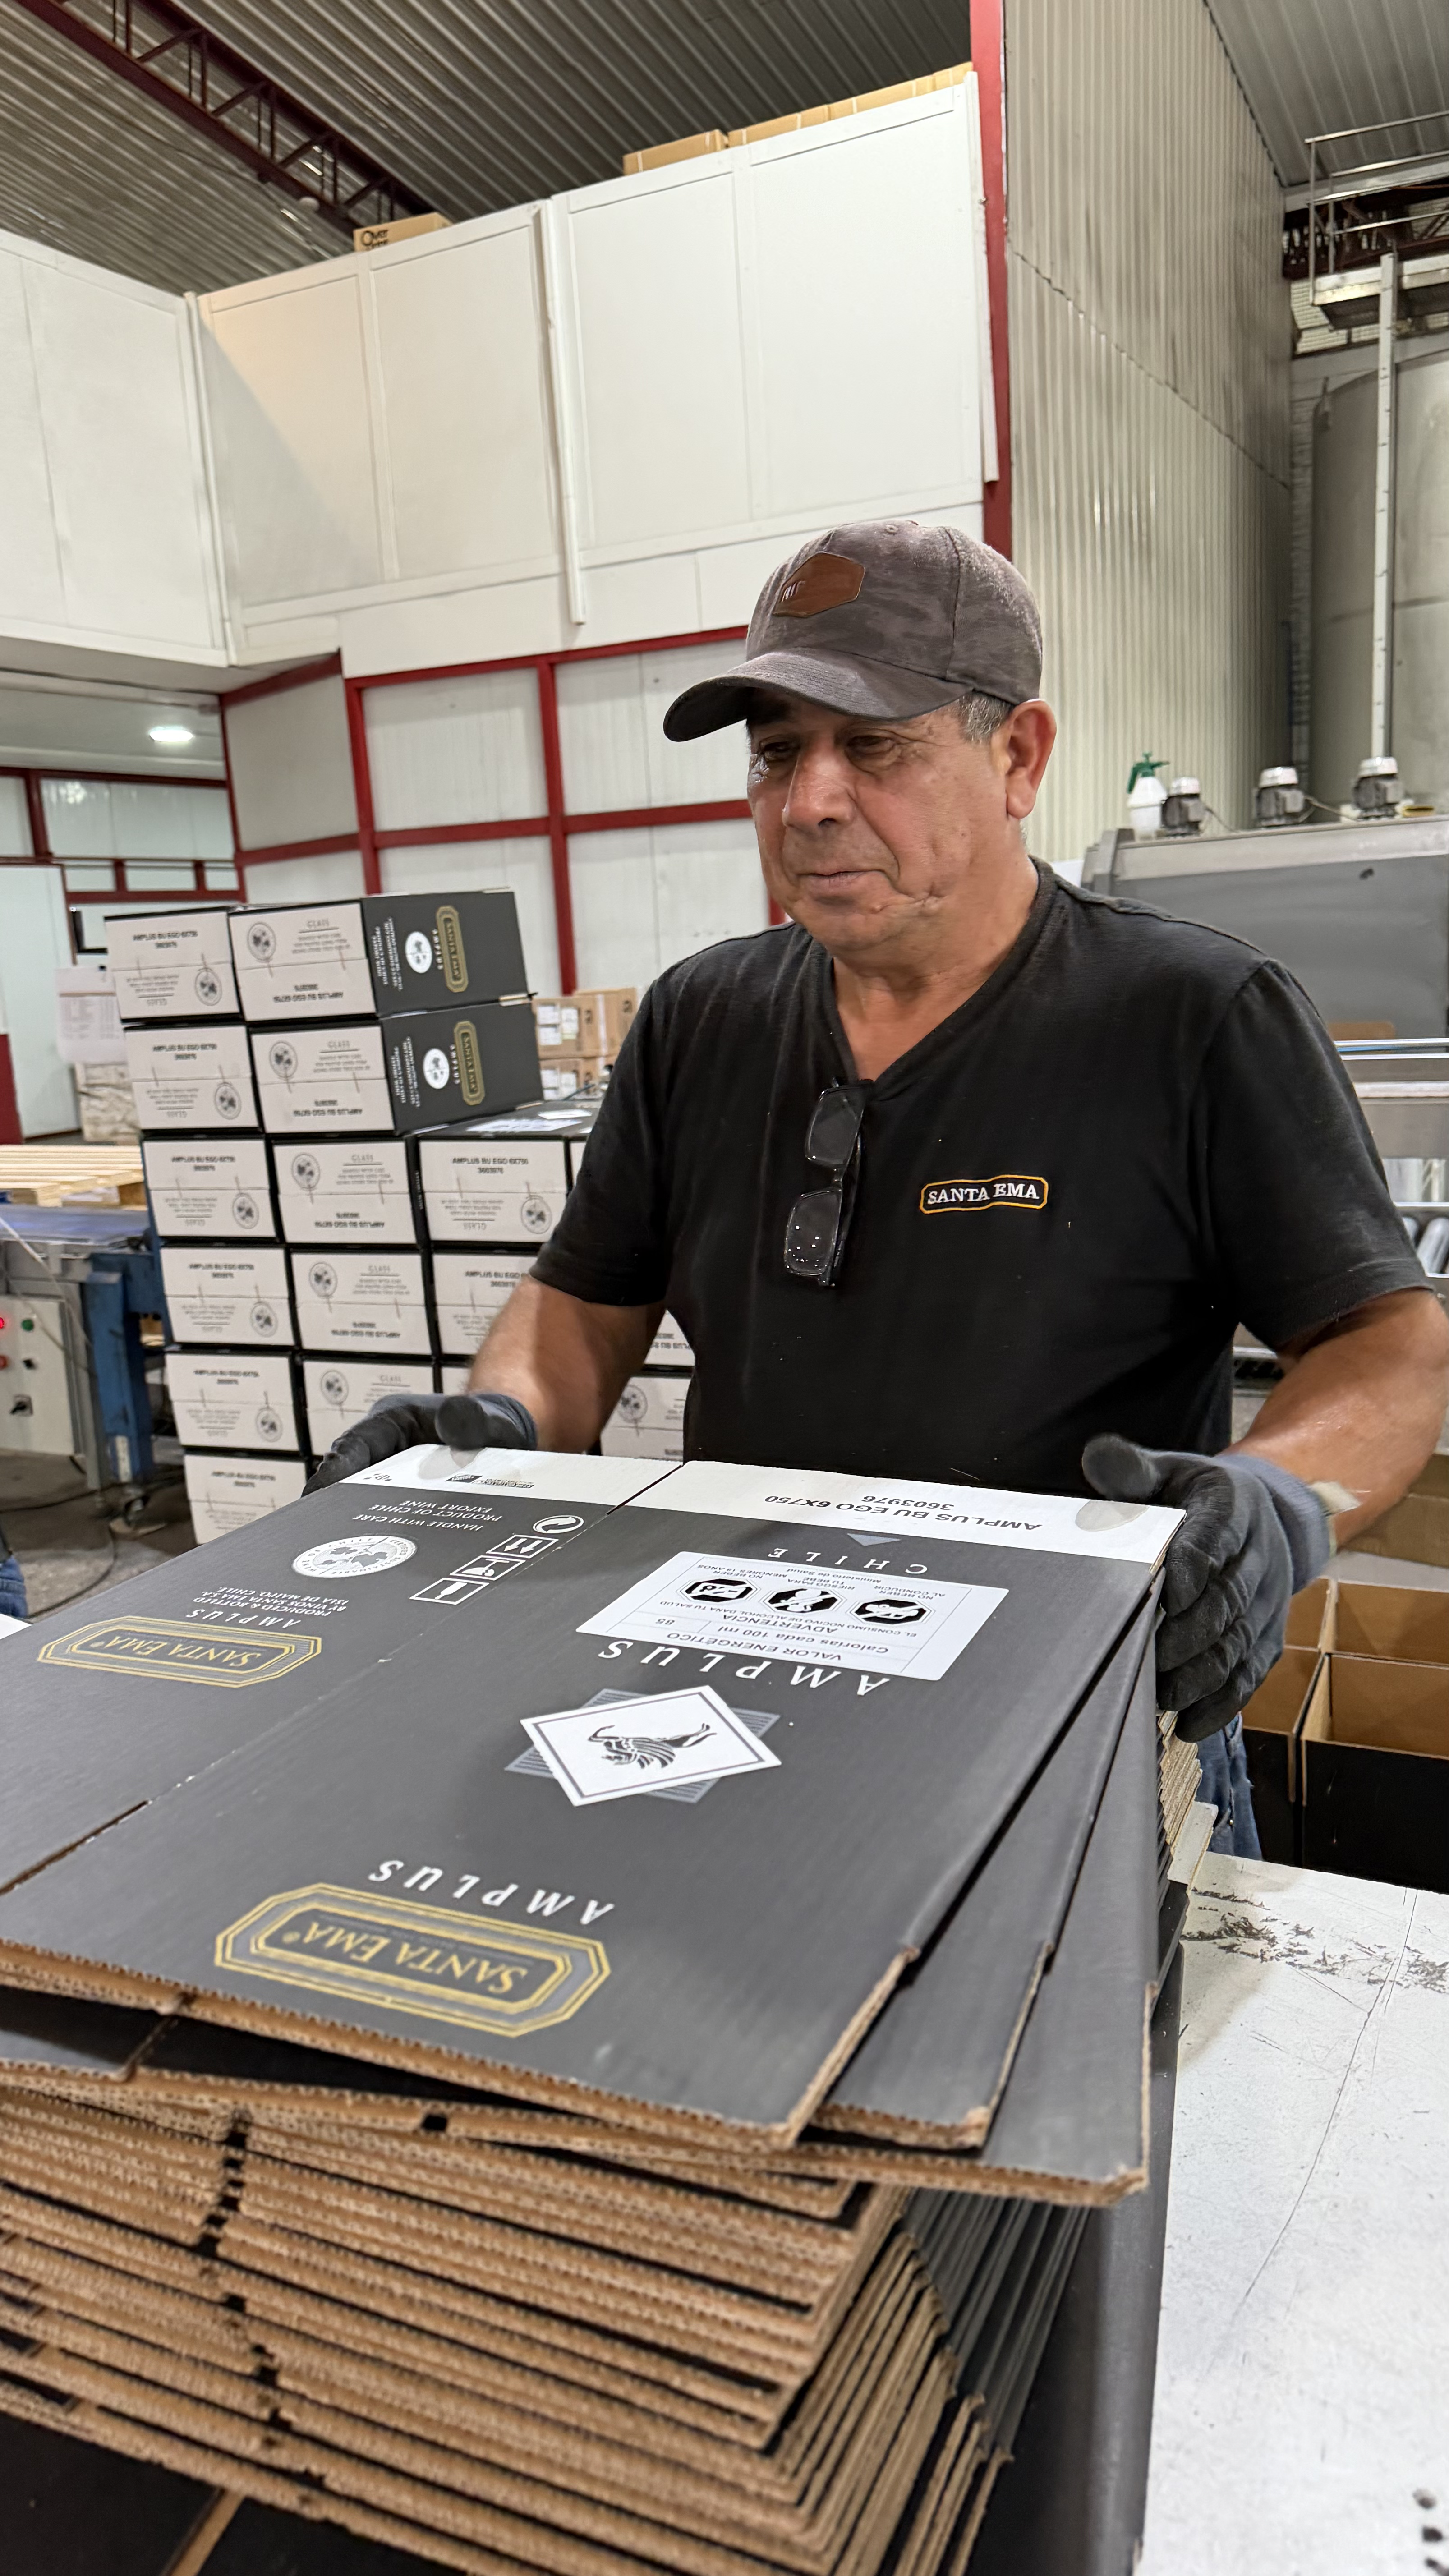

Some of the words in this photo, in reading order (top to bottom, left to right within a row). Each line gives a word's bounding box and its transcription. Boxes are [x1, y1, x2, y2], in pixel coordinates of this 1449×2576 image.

[927, 1187, 990, 1205] SANTA
[992, 1182, 1040, 1200] EMA
[399, 1500, 437, 1509] WINE
[764, 1495, 831, 1508] 6X750
[861, 1495, 954, 1511] 3603976
[368, 1504, 411, 1513] CHILE
[437, 1504, 492, 1513] EXPORT
[835, 1502, 889, 1514] EGO
[894, 1509, 930, 1519] BU
[352, 1514, 388, 1522] CARE
[388, 1518, 426, 1526] WITH
[432, 1511, 502, 1522] PRODUCT
[935, 1513, 1043, 1531] AMPLUS
[427, 1521, 483, 1531] HANDLE
[768, 1548, 928, 1574] CHILE
[193, 1597, 249, 1608] BOTTLED
[261, 1605, 332, 1617] PRODUCED
[185, 1609, 301, 1628] AMPLUS
[722, 1614, 838, 1633] ADVERTENCIA
[742, 1629, 768, 1638] 100
[776, 1633, 815, 1643] cada
[176, 1643, 261, 1667] SANTA
[782, 1647, 842, 1661] VALOR
[598, 1640, 890, 1696] AMPLUS
[368, 1859, 615, 1925] AMPLUS
[394, 1940, 529, 1994] SANTA
